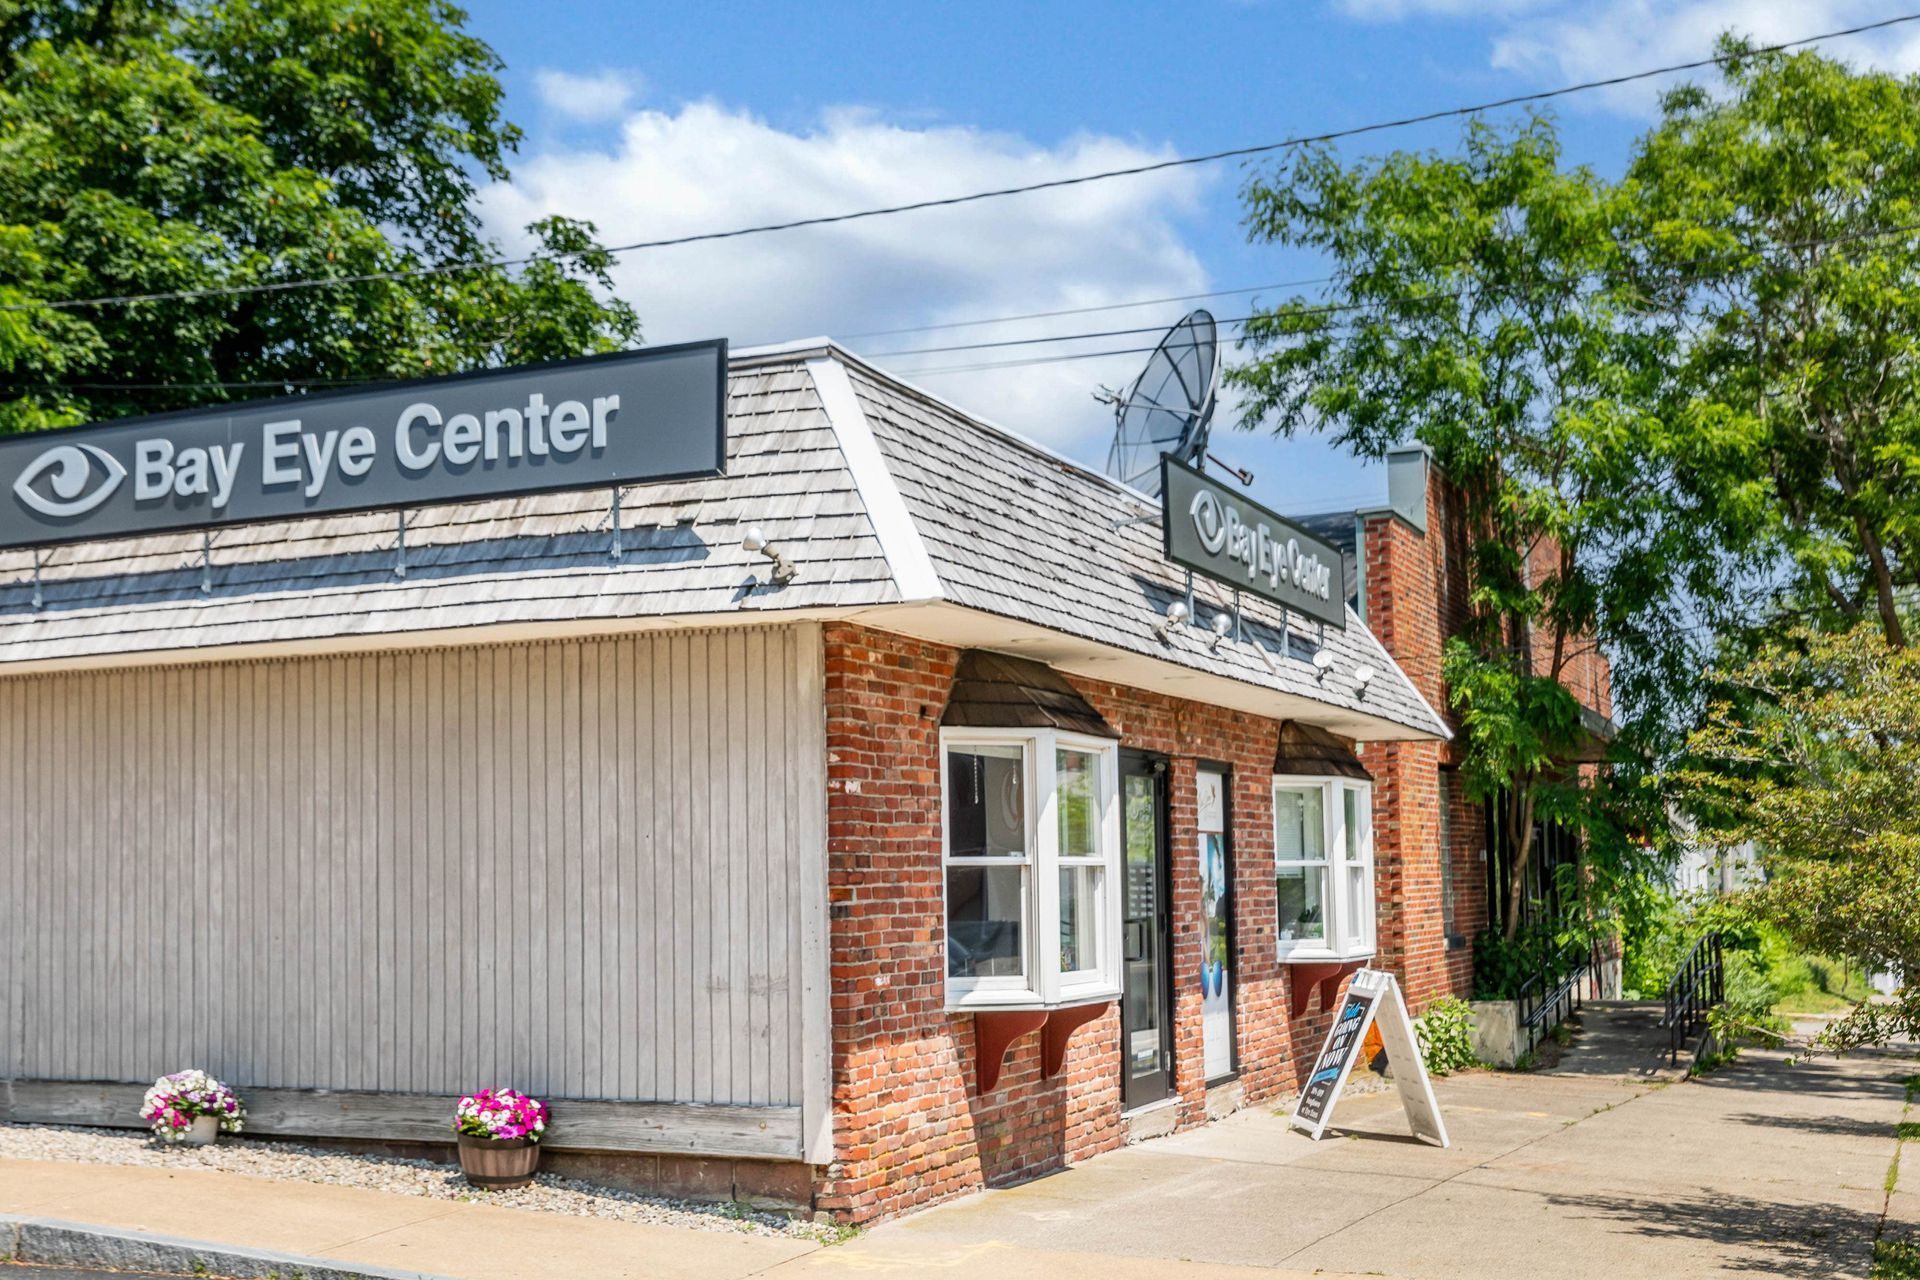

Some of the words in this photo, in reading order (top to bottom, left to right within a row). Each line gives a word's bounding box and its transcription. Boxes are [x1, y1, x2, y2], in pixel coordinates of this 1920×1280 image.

[135, 438, 245, 508] Bay
[263, 419, 376, 498] Eye
[395, 393, 620, 470] Center
[1225, 505, 1257, 579] Bay
[1257, 523, 1287, 588] Eye
[1287, 538, 1331, 601] Center
[1333, 1016, 1361, 1037] GOING
[1332, 1033, 1348, 1050] ON
[1318, 1046, 1349, 1071] NOW
